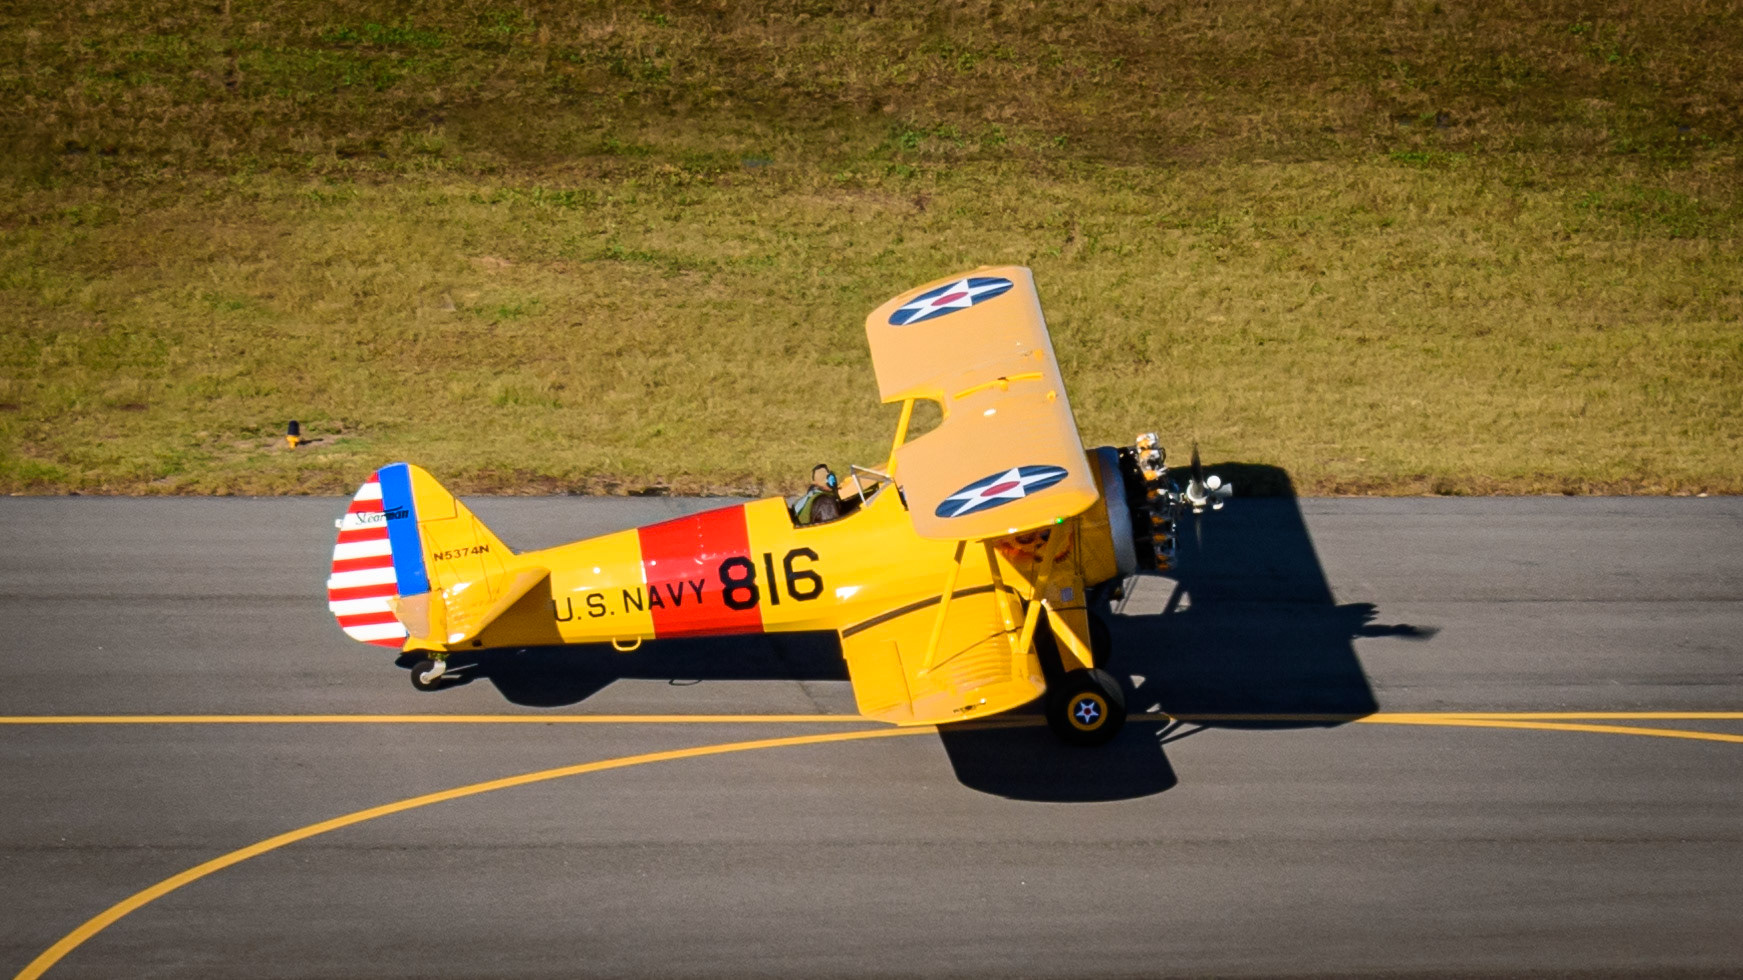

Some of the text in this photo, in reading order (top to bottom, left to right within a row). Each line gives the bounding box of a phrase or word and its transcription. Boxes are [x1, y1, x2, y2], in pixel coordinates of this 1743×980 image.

[355, 505, 409, 526] Stearman
[433, 544, 490, 562] N5374N
[718, 547, 824, 611] 816
[552, 578, 705, 622] U.S. NAVY
